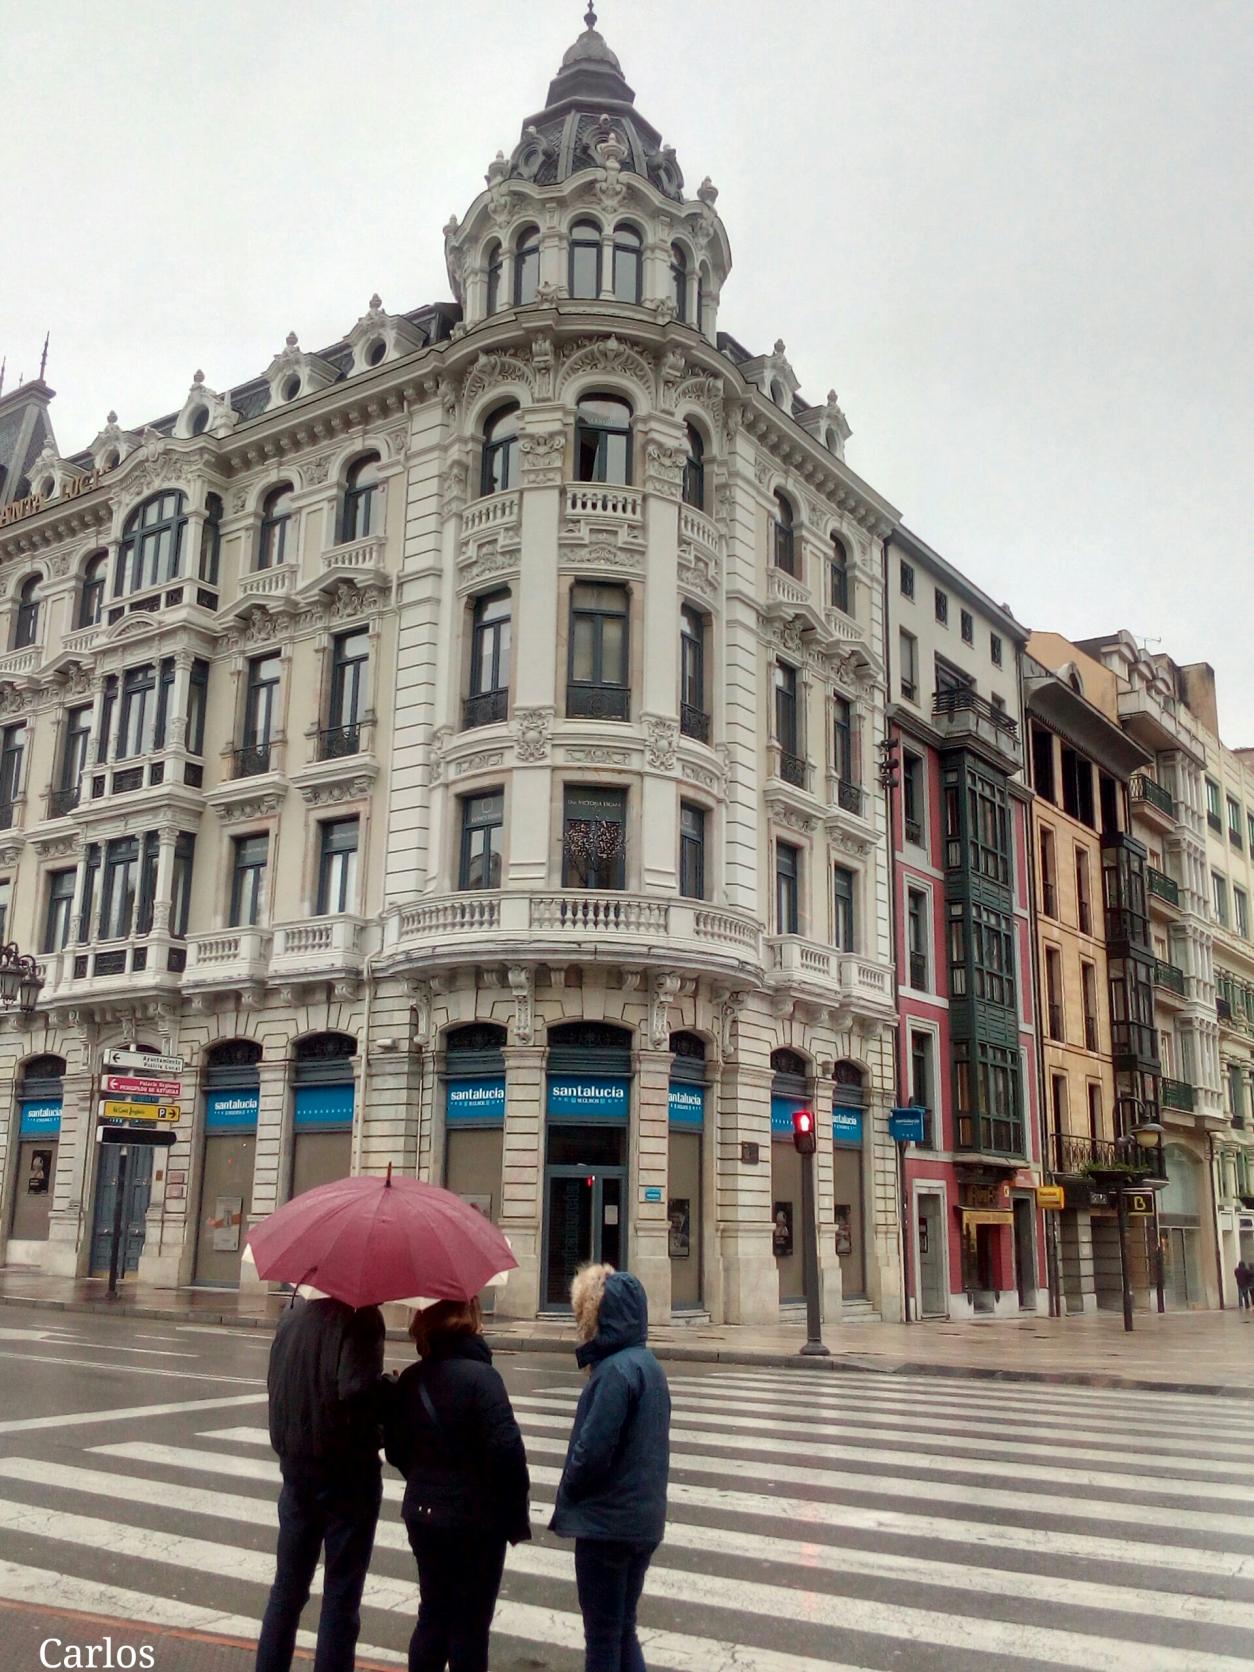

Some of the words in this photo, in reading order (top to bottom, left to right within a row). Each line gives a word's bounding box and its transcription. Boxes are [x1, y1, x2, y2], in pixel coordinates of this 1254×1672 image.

[450, 1087, 504, 1100] santalucía
[552, 1085, 624, 1098] santalucía
[214, 1098, 258, 1110] santalucía
[668, 1092, 702, 1106] antalucía
